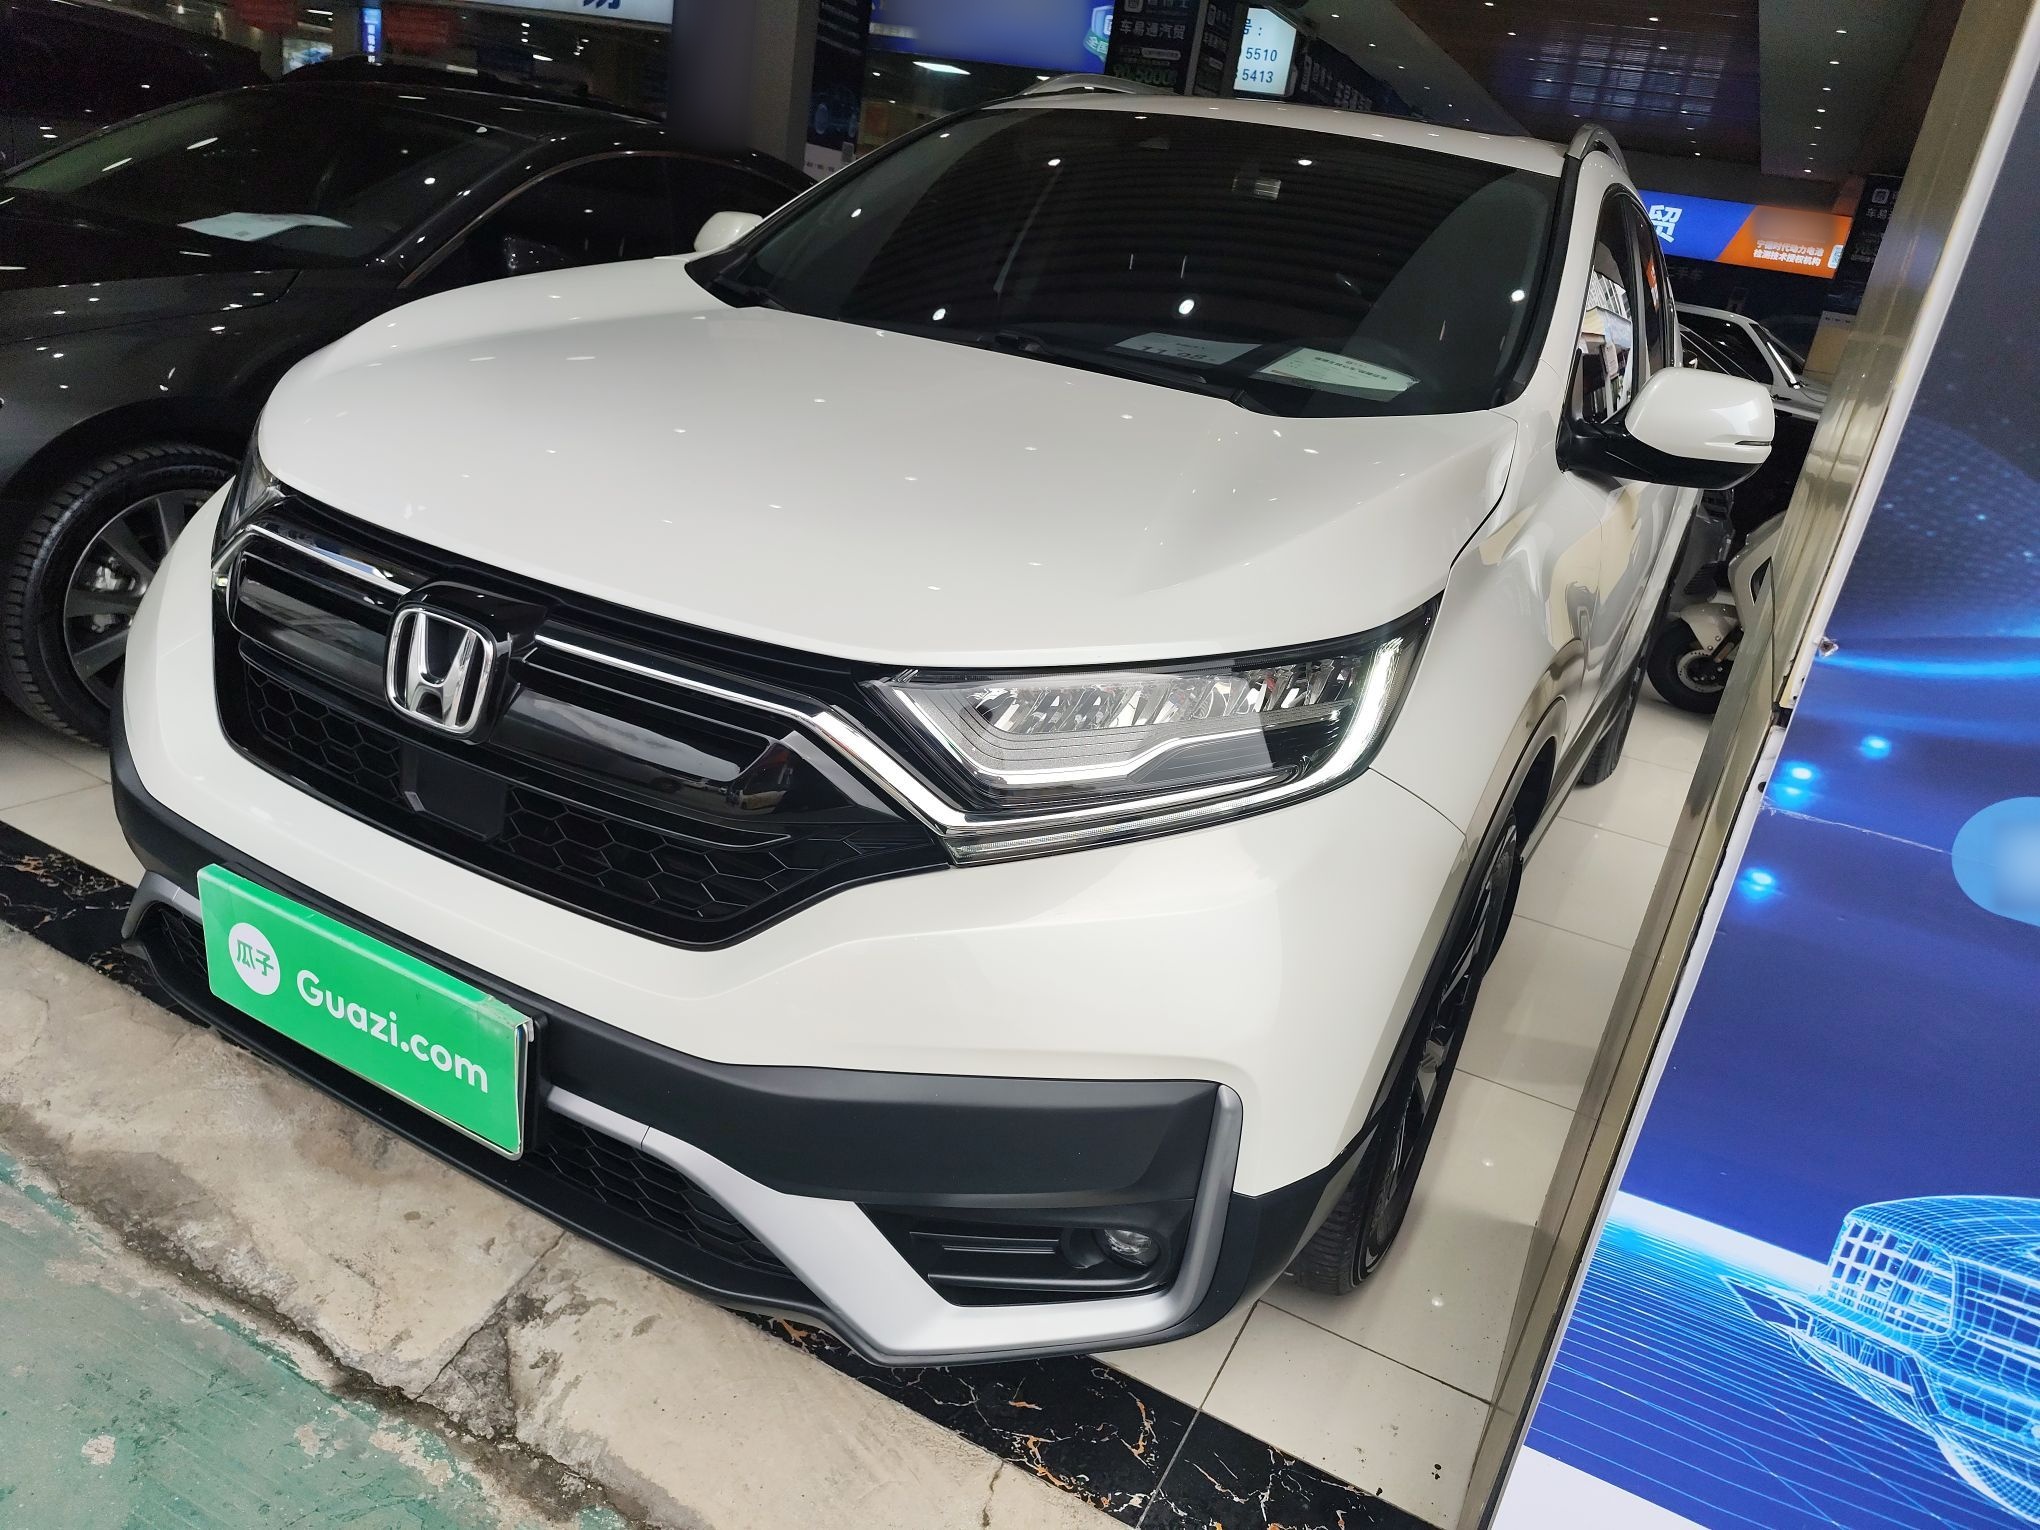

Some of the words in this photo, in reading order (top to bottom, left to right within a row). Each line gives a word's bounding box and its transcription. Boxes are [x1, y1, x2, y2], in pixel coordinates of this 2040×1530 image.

[1120, 20, 1186, 40] 车易通汽贸
[1245, 47, 1278, 62] 5510
[1241, 69, 1274, 84] 5413
[1753, 249, 1822, 267] 检测技术授权机构
[235, 938, 275, 978] 瓜子
[296, 969, 490, 1094] Guazi.com
